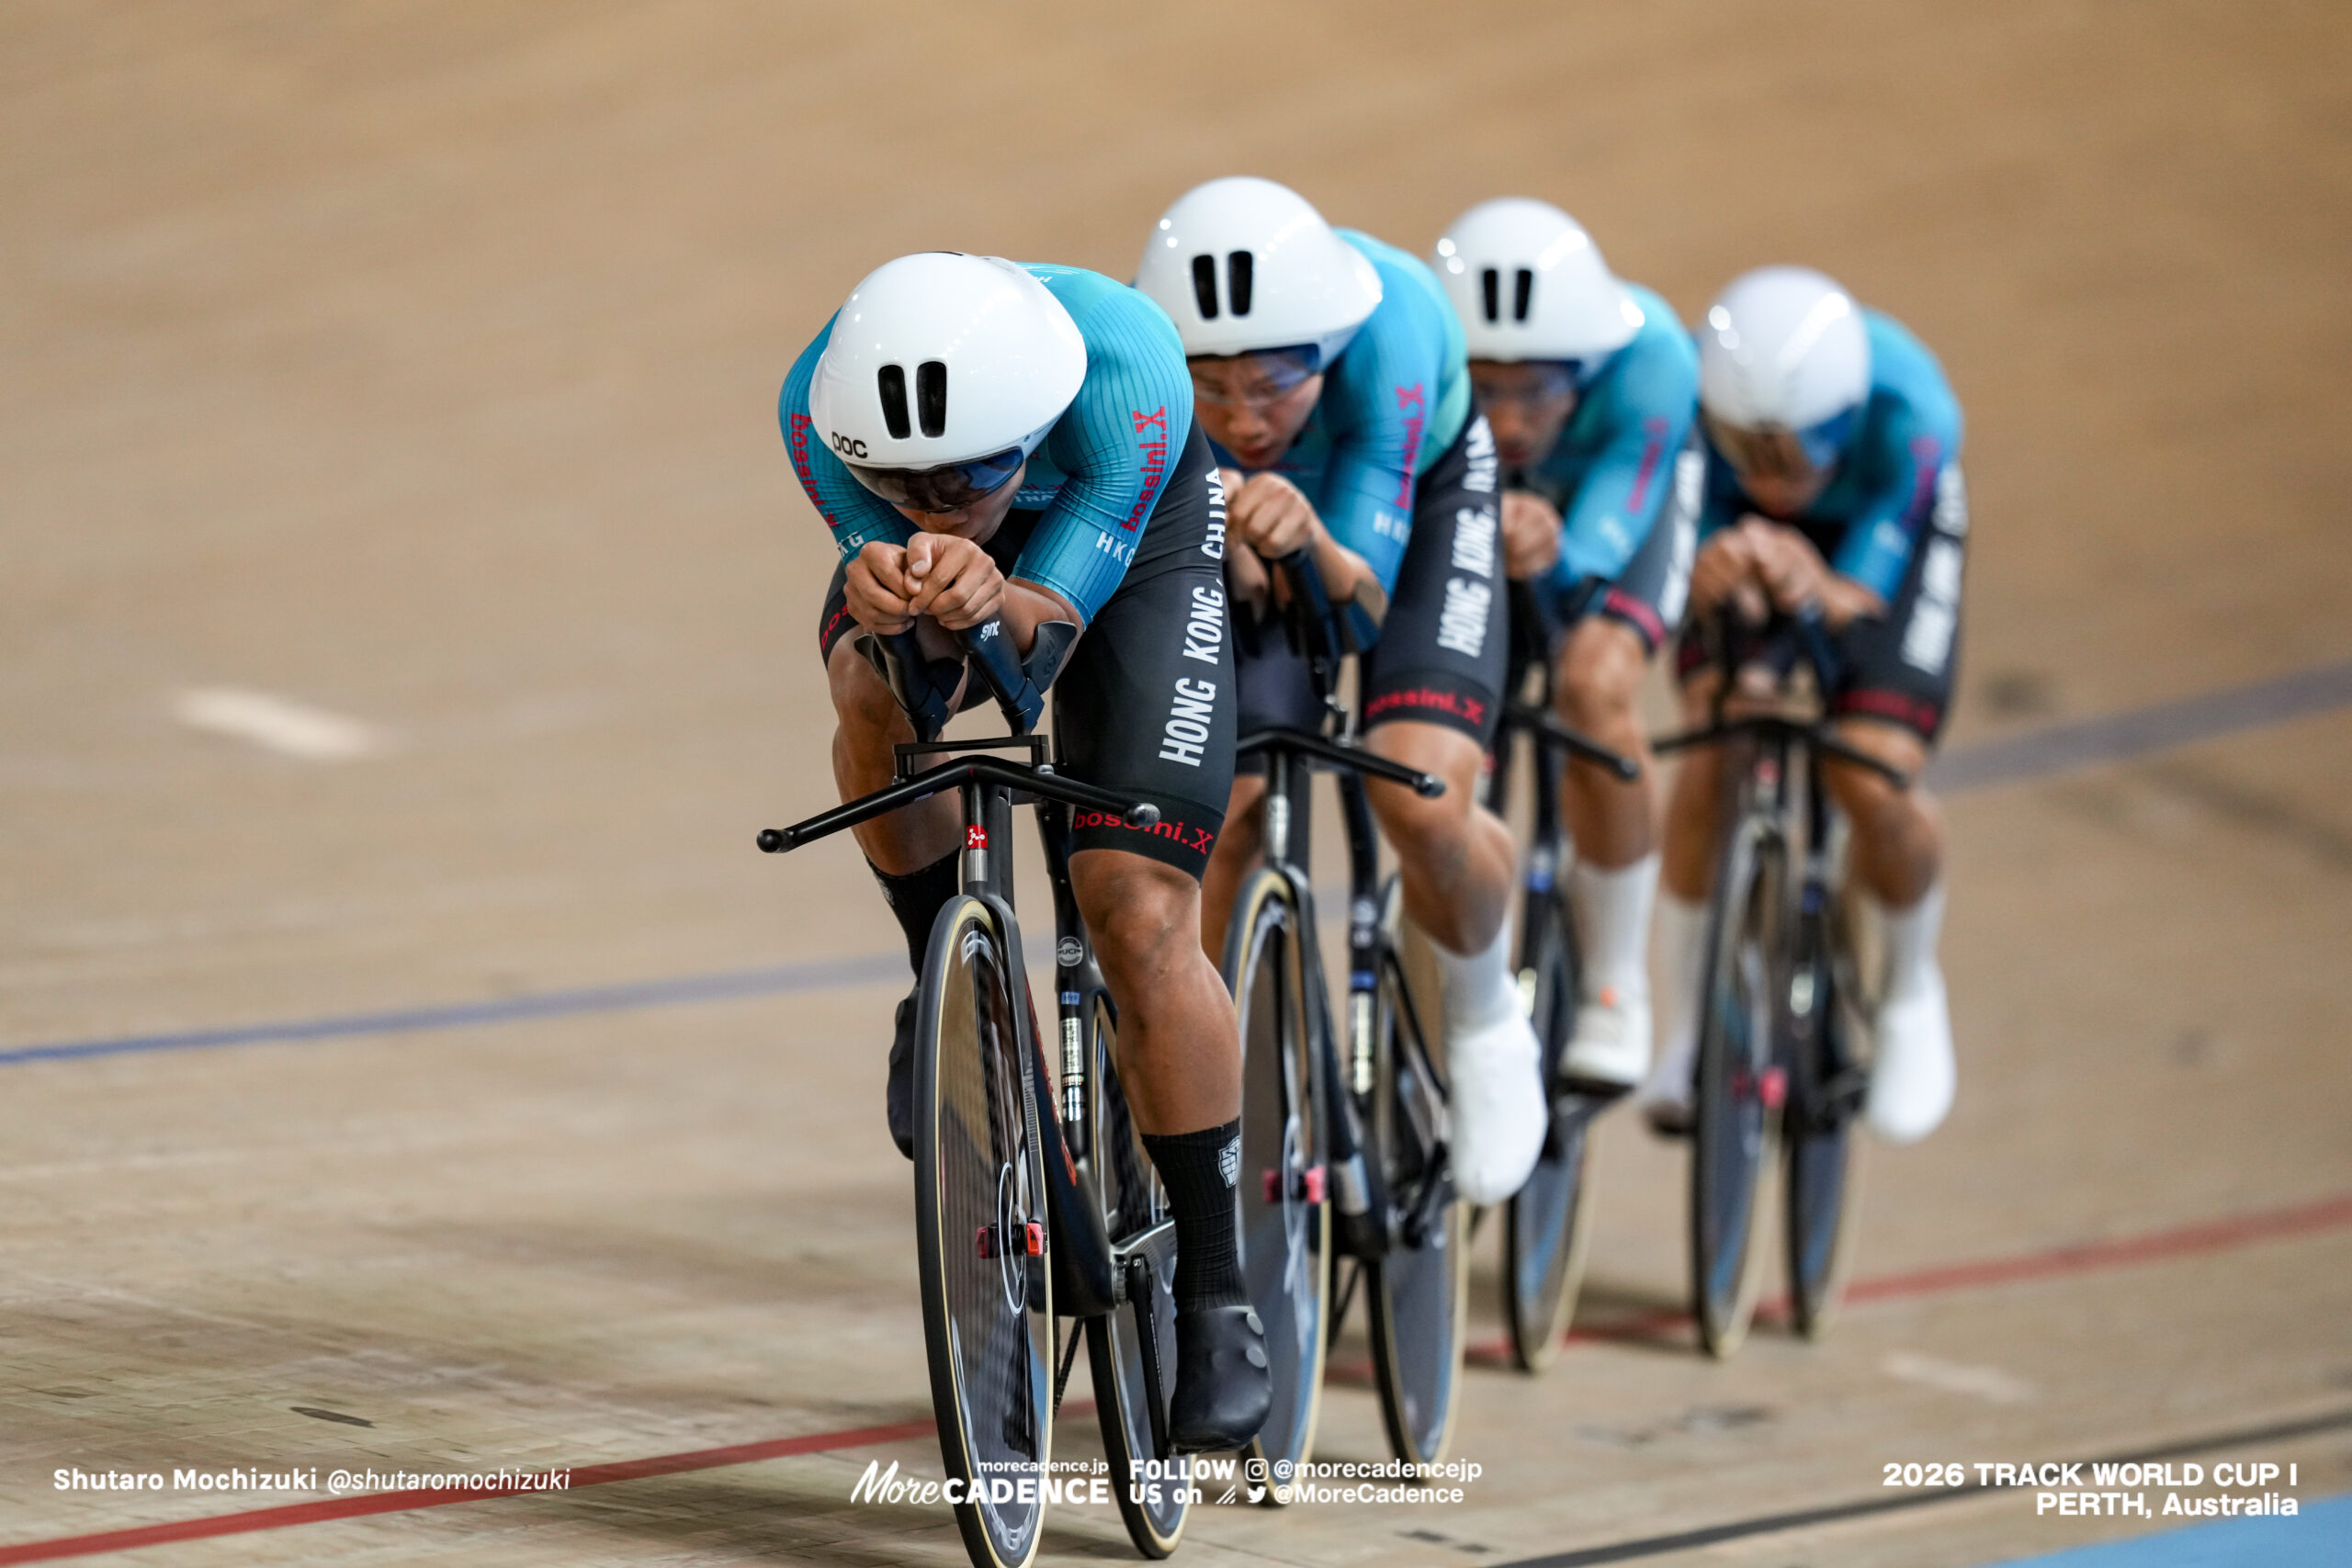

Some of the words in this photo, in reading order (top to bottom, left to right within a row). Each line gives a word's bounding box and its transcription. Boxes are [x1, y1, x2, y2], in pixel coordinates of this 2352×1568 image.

[1121, 406, 1167, 532] bossini.X
[1159, 678, 1216, 767] HONG
[1201, 467, 1226, 560] CHINA
[1437, 577, 1493, 659] HONG
[1074, 812, 1214, 855] bosni.X
